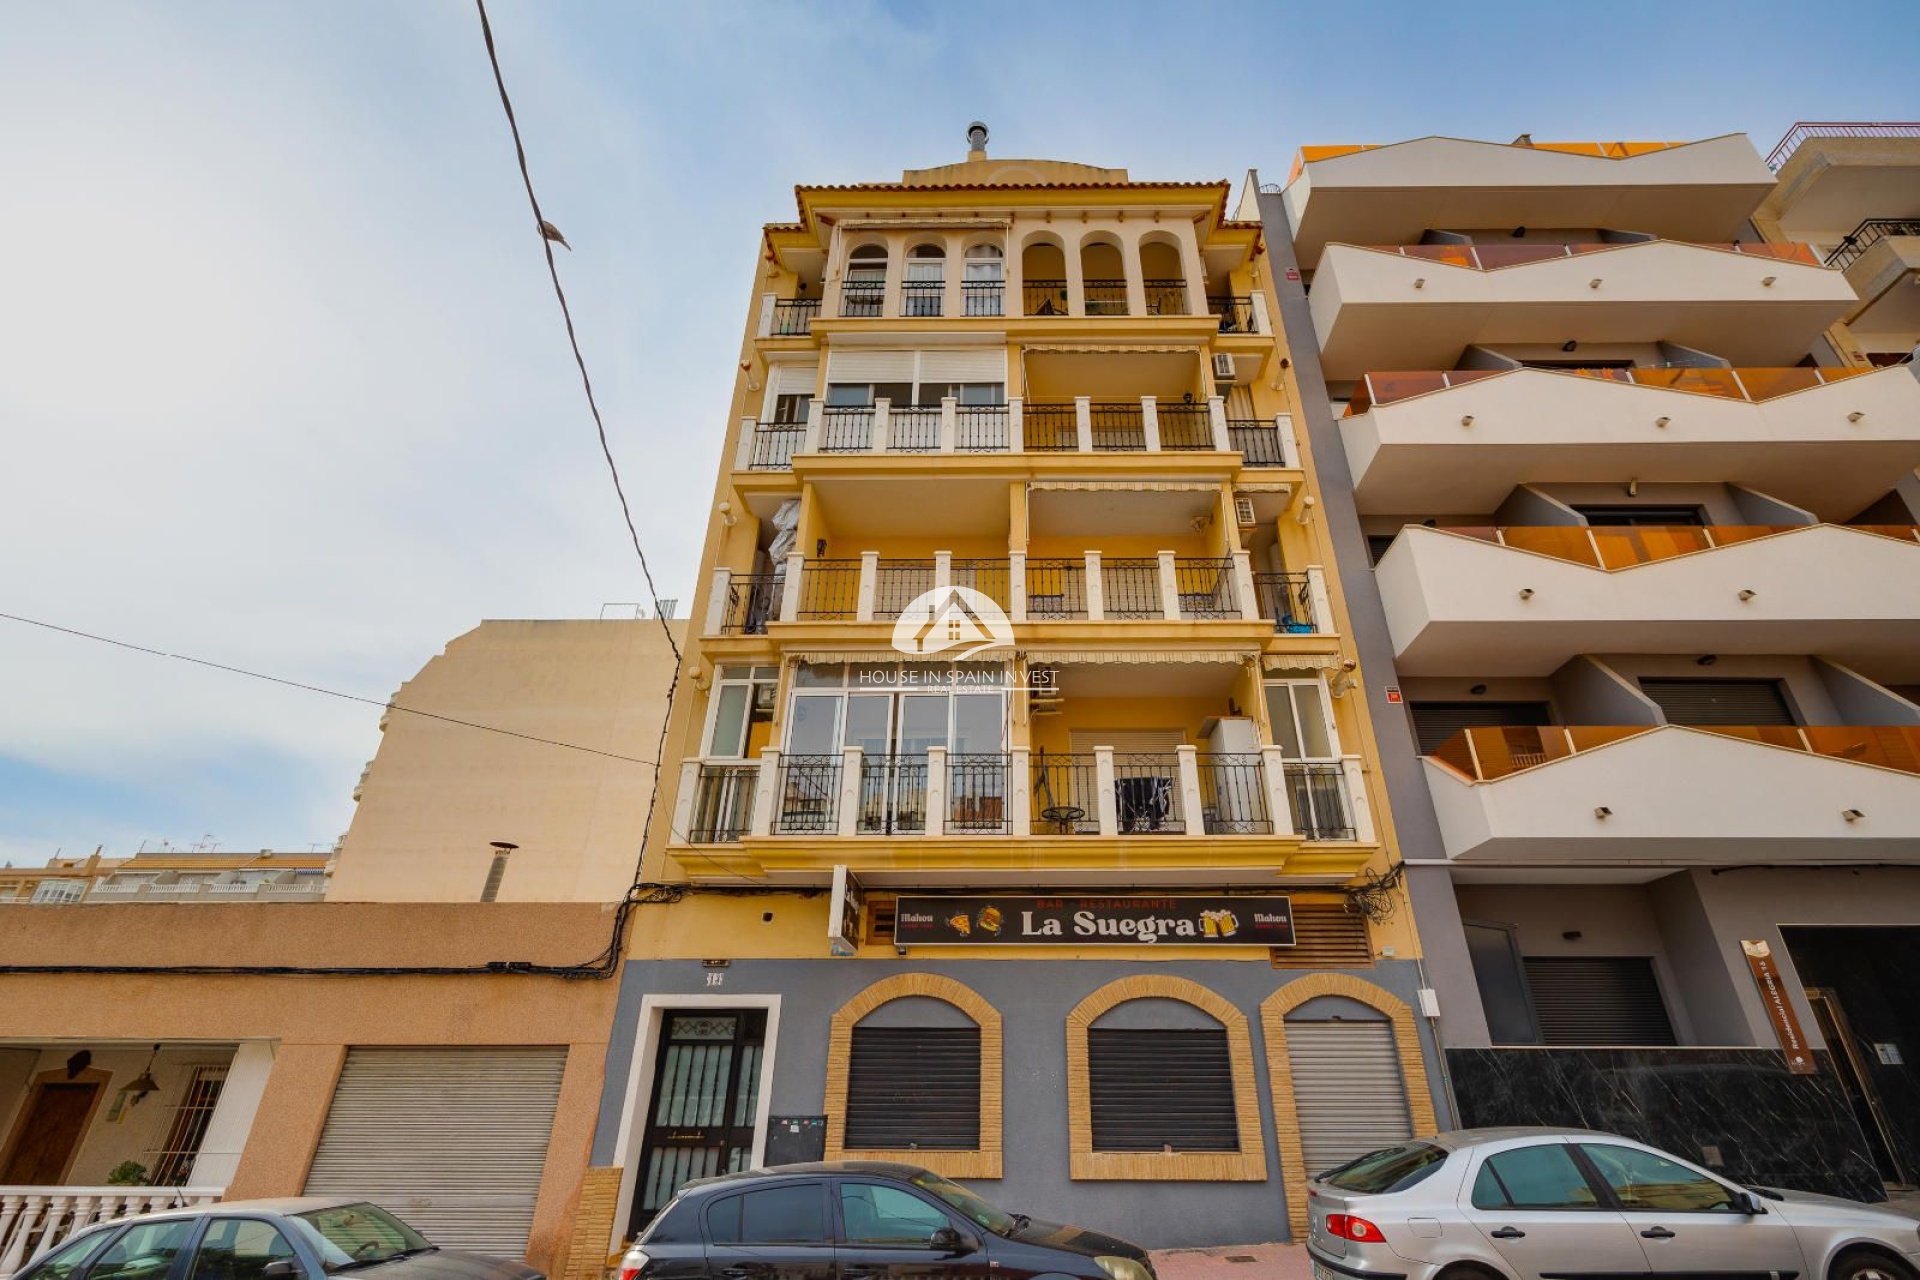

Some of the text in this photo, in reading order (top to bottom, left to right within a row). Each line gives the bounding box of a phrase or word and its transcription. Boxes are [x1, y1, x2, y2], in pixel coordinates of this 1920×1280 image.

[1037, 899, 1177, 910] BAR RESTAURANTE
[1021, 910, 1197, 943] La Suegra
